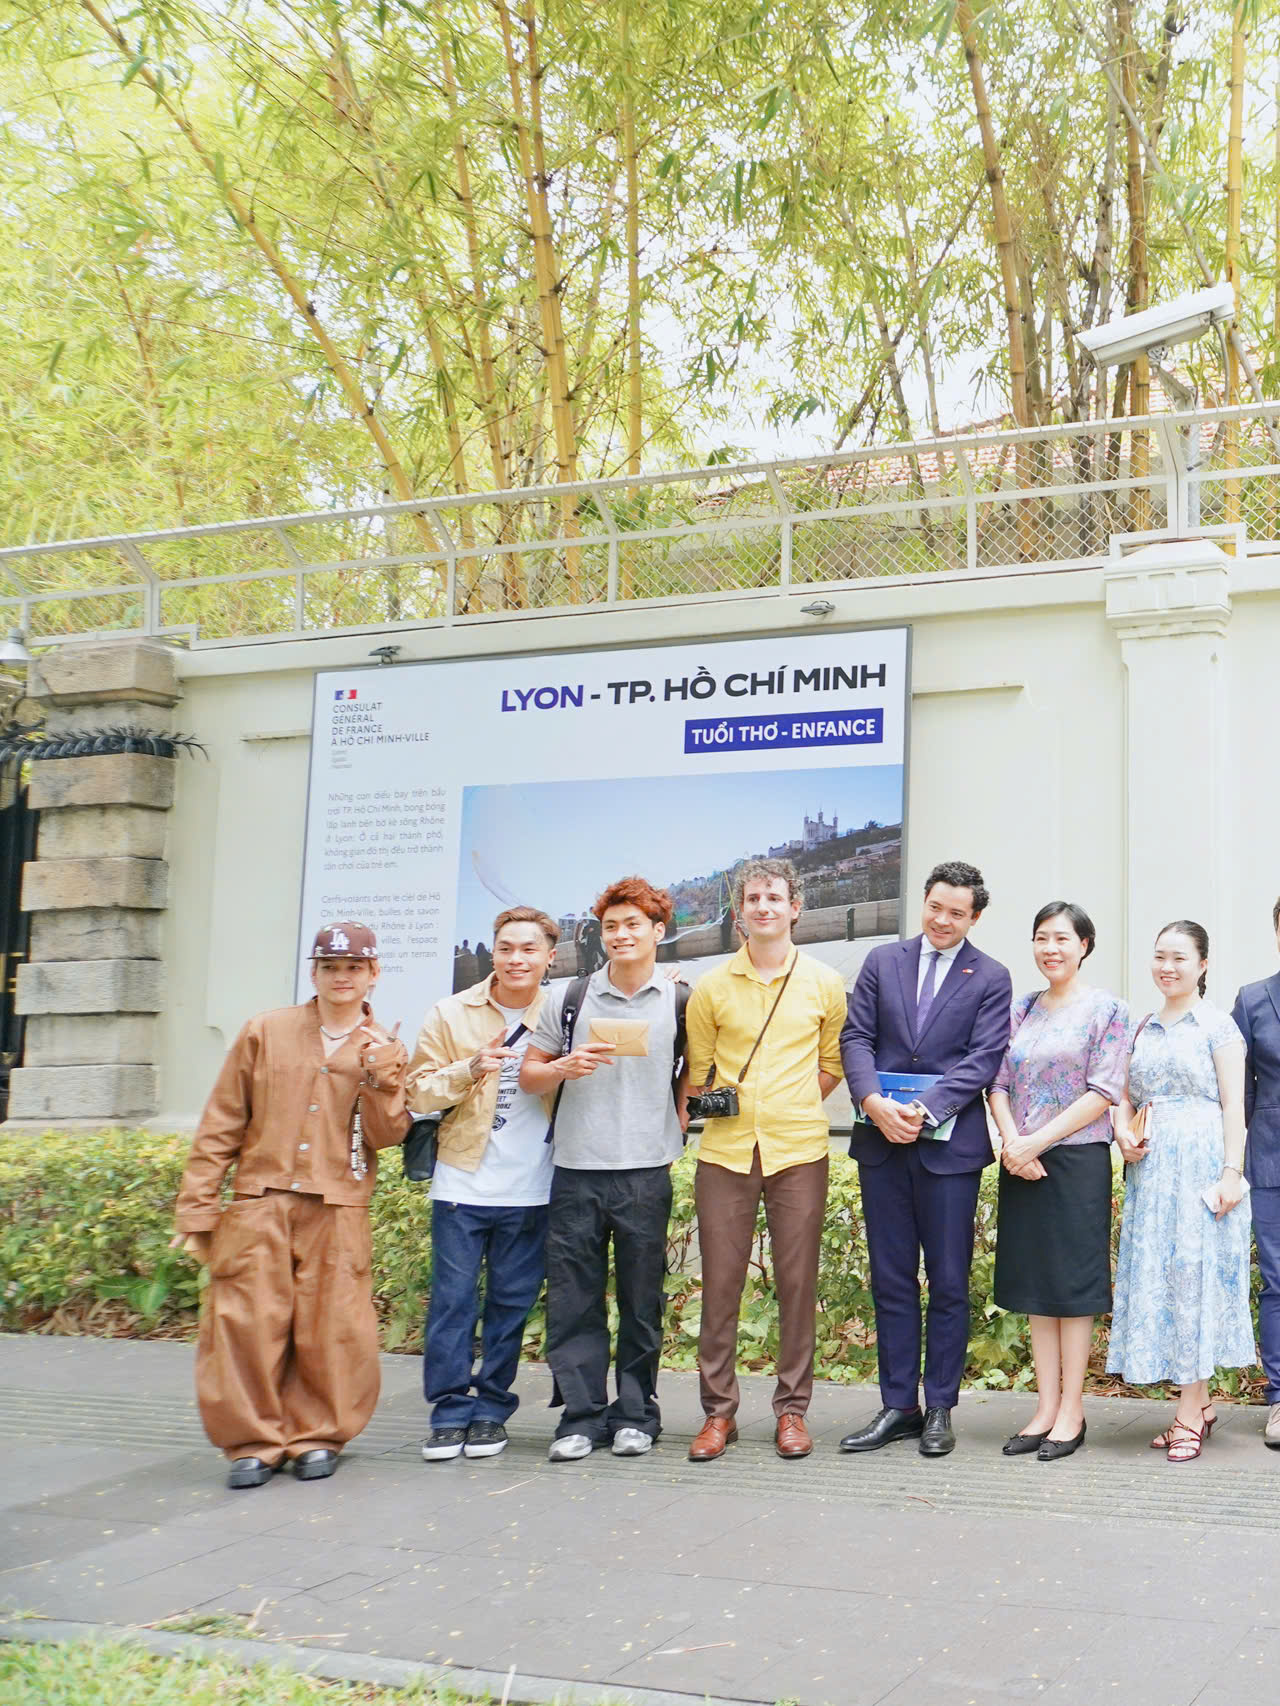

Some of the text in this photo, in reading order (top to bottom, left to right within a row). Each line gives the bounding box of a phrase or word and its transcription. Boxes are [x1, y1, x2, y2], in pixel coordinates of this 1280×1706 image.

[501, 684, 584, 712] LYON
[607, 681, 656, 705] TP.
[664, 666, 717, 701] HỒ
[724, 665, 788, 696] CHÍ
[793, 663, 886, 693] MINH
[333, 702, 382, 714] CONSULAT
[332, 713, 374, 725] GÉNÉRAL
[332, 724, 382, 736] DE FRANCE
[692, 722, 733, 745] TUỔI
[739, 721, 779, 742] THƠ
[792, 718, 876, 740] ENFANCE
[357, 736, 374, 745] CHI
[376, 732, 430, 744] MINH-VILLE
[330, 928, 350, 951] LA
